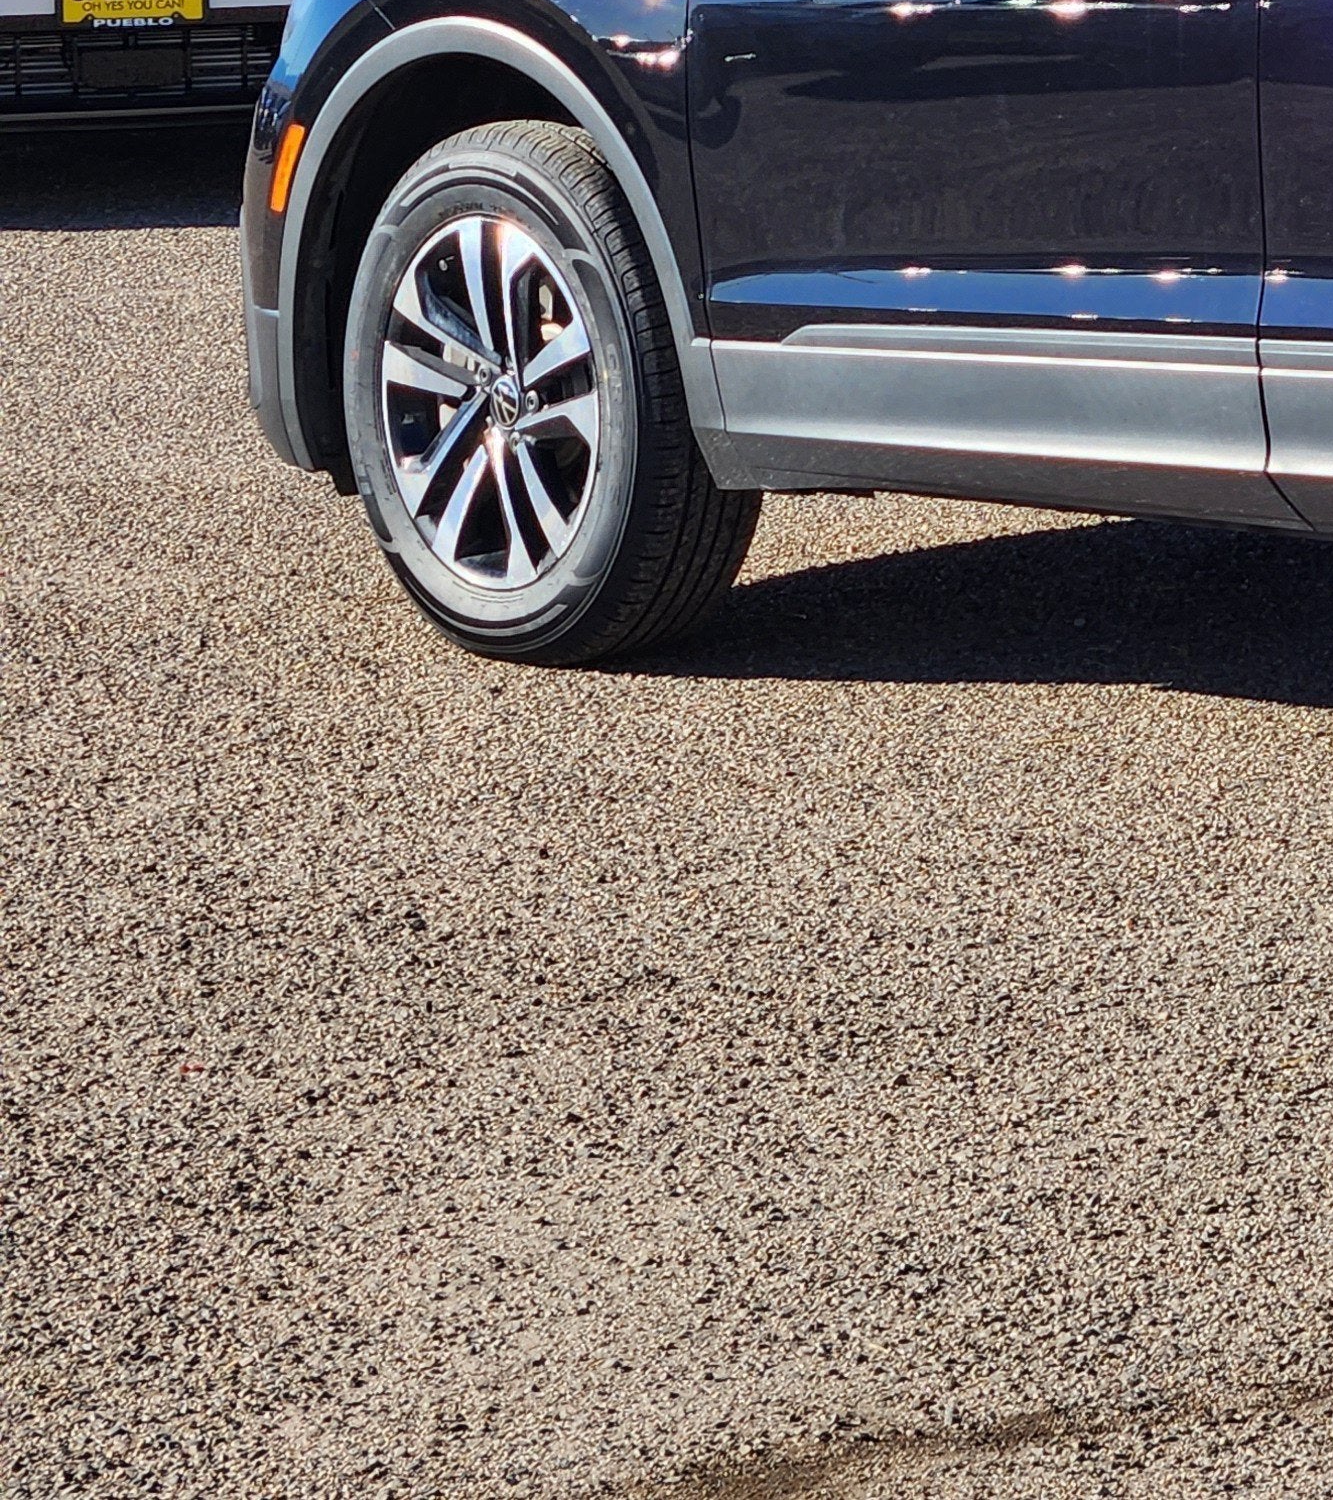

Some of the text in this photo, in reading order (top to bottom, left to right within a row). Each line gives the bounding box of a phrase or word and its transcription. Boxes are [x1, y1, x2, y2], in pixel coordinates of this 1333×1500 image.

[82, 0, 184, 12] OH YES YOU CAN!
[93, 16, 174, 28] PUEBLO
